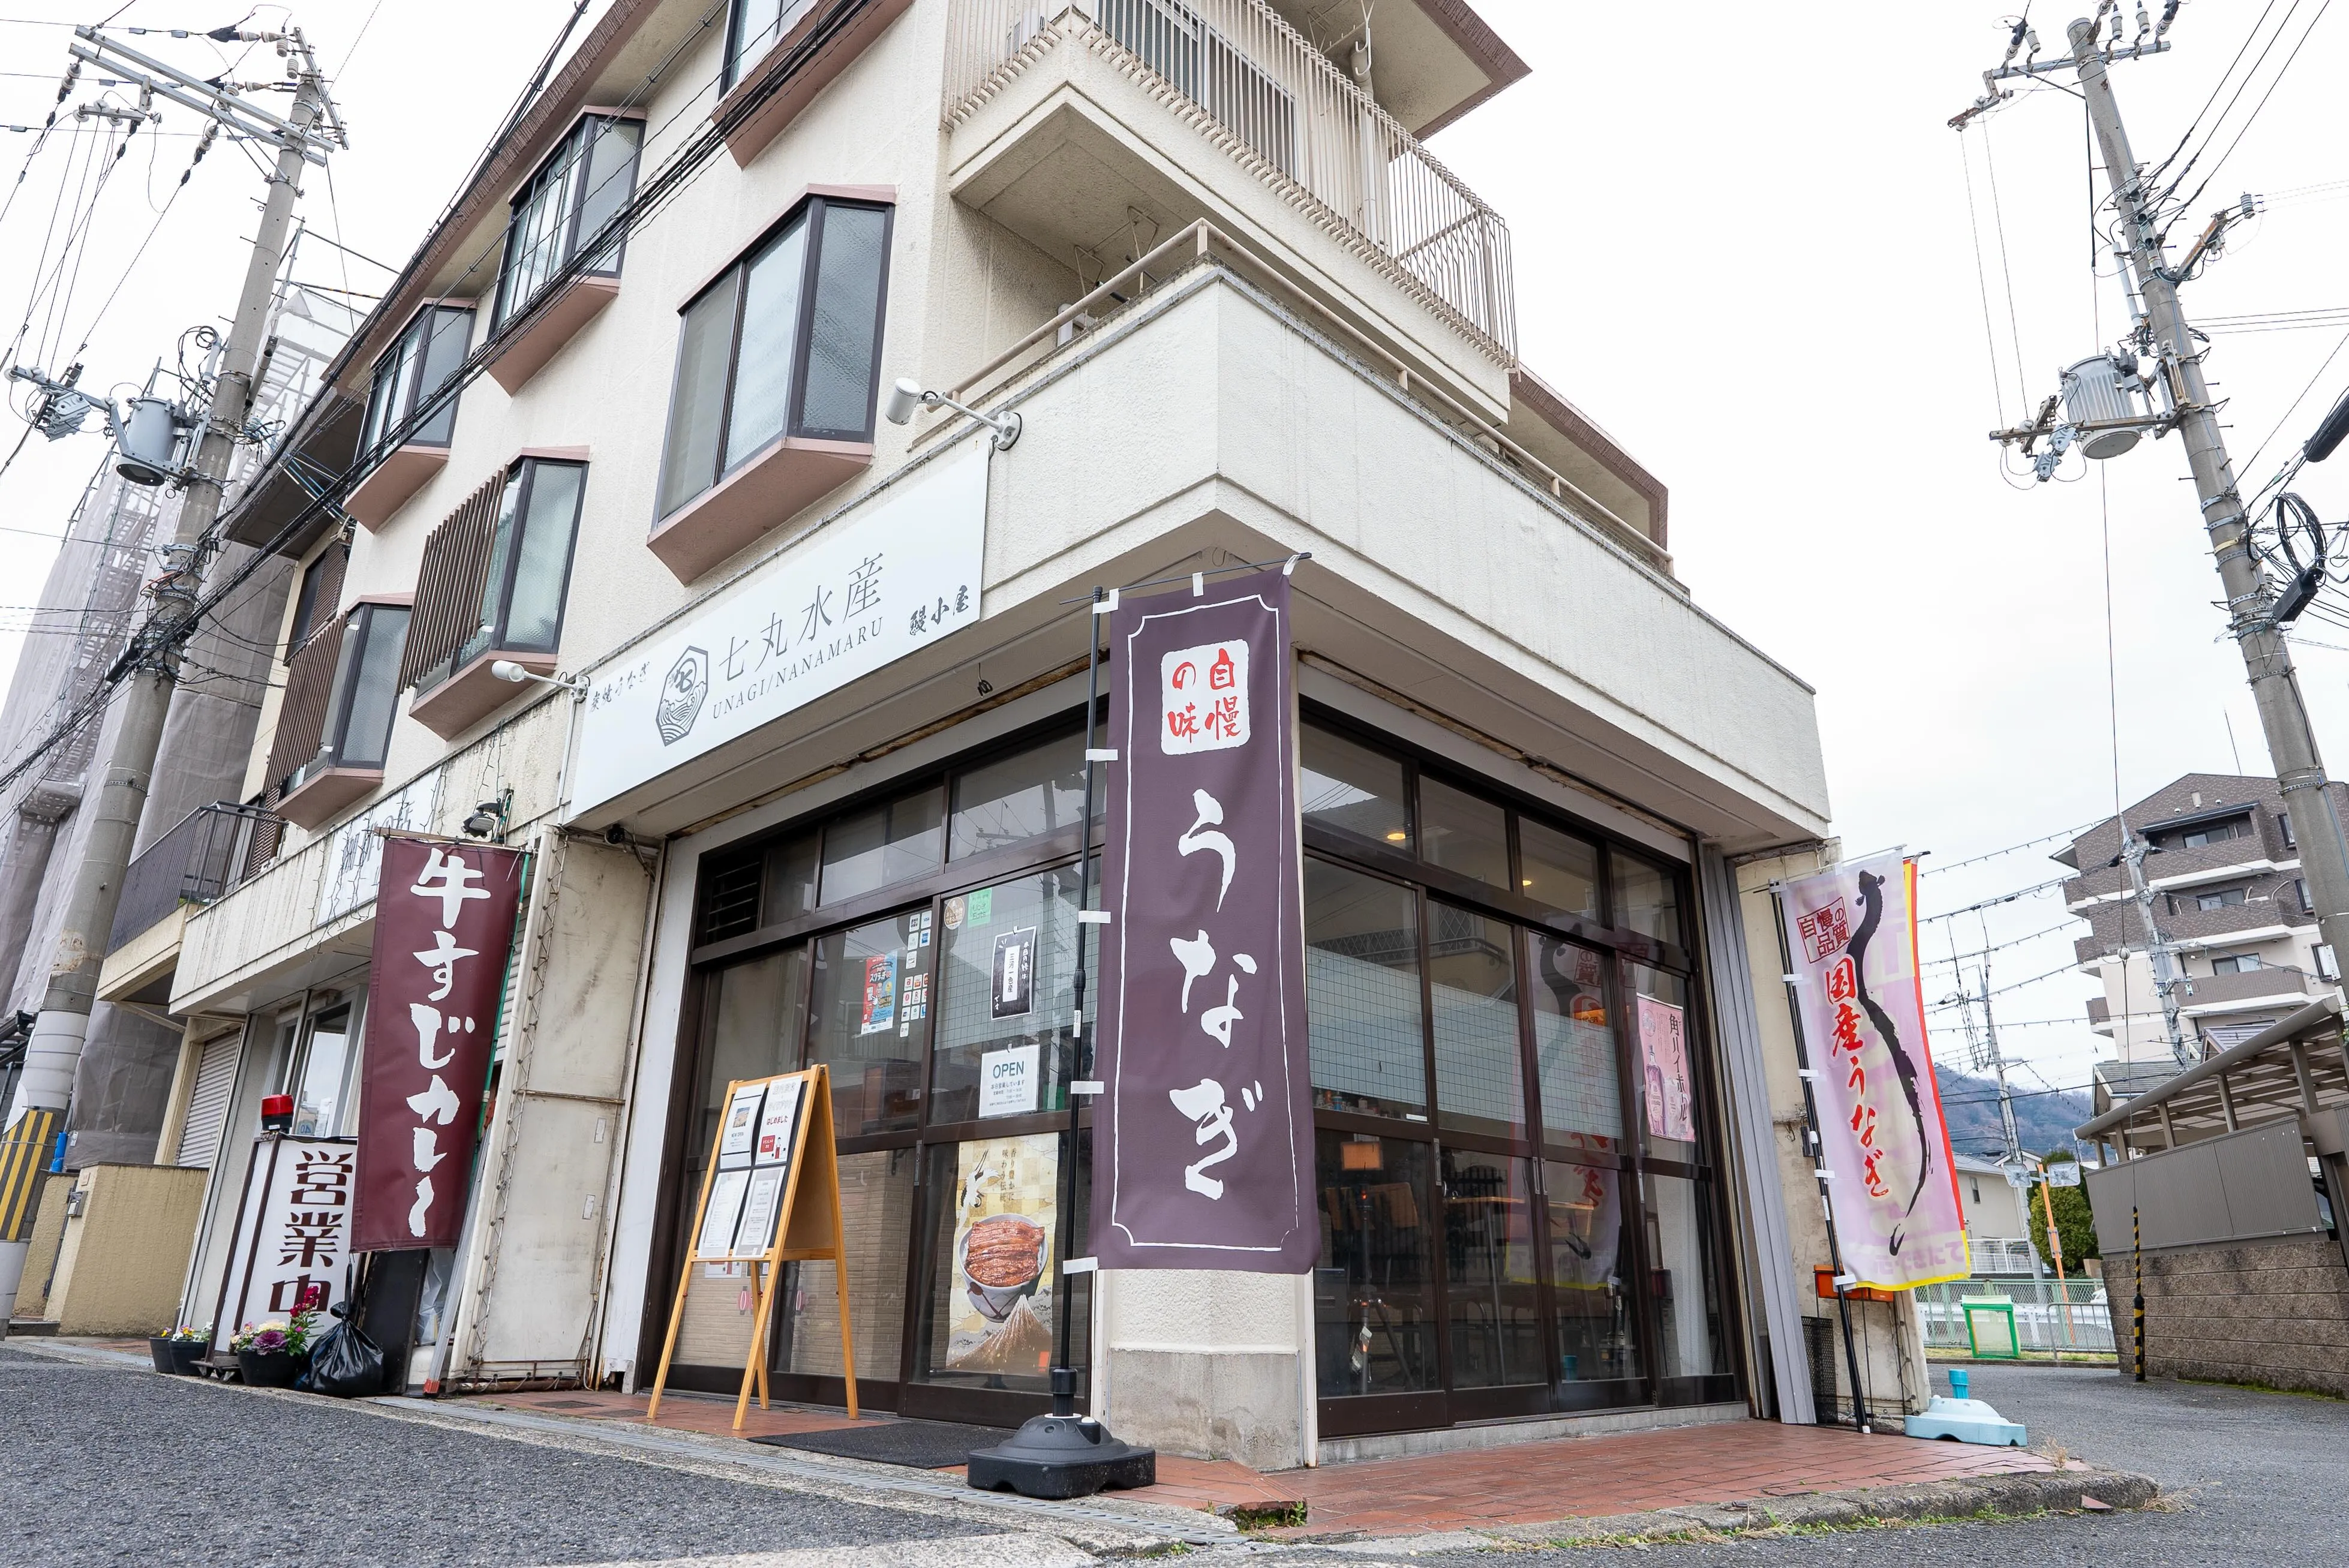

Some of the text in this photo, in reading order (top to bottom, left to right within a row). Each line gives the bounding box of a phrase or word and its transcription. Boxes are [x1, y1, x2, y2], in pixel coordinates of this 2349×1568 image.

[712, 617, 884, 720] UNAGI/NANAMARU
[718, 552, 884, 681] 七丸水産
[910, 585, 969, 636] 鰻小屋
[407, 848, 491, 1238] 牛すじカレー
[1169, 788, 1263, 1200] うなぎ
[993, 1061, 1024, 1079] OPEN
[1669, 1014, 1688, 1121] 角ハイボール
[1825, 957, 1889, 1197] 国産うなぎ
[268, 1150, 353, 1327] 営業中
